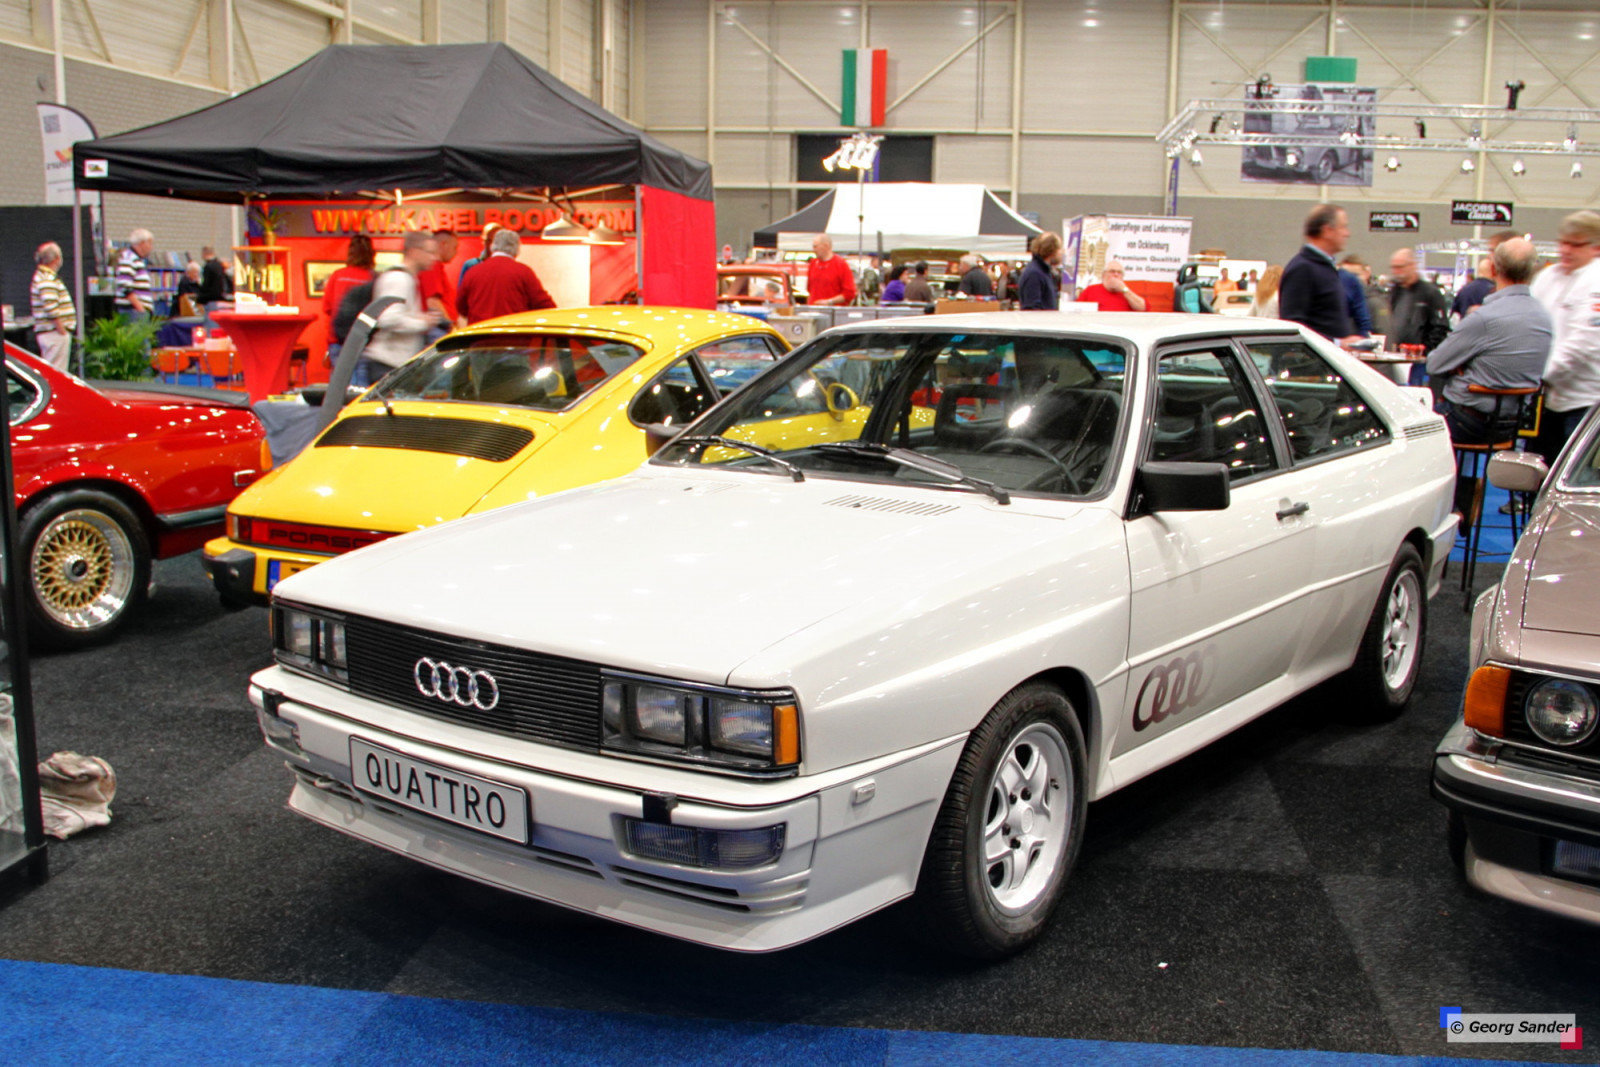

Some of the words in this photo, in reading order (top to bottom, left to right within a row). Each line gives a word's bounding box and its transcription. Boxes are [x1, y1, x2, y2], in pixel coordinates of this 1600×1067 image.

[1453, 203, 1495, 213] JACOBS
[311, 207, 635, 234] WWW.KABELBOOCOM
[269, 529, 375, 549] PORSC
[366, 752, 506, 829] QUATTRO
